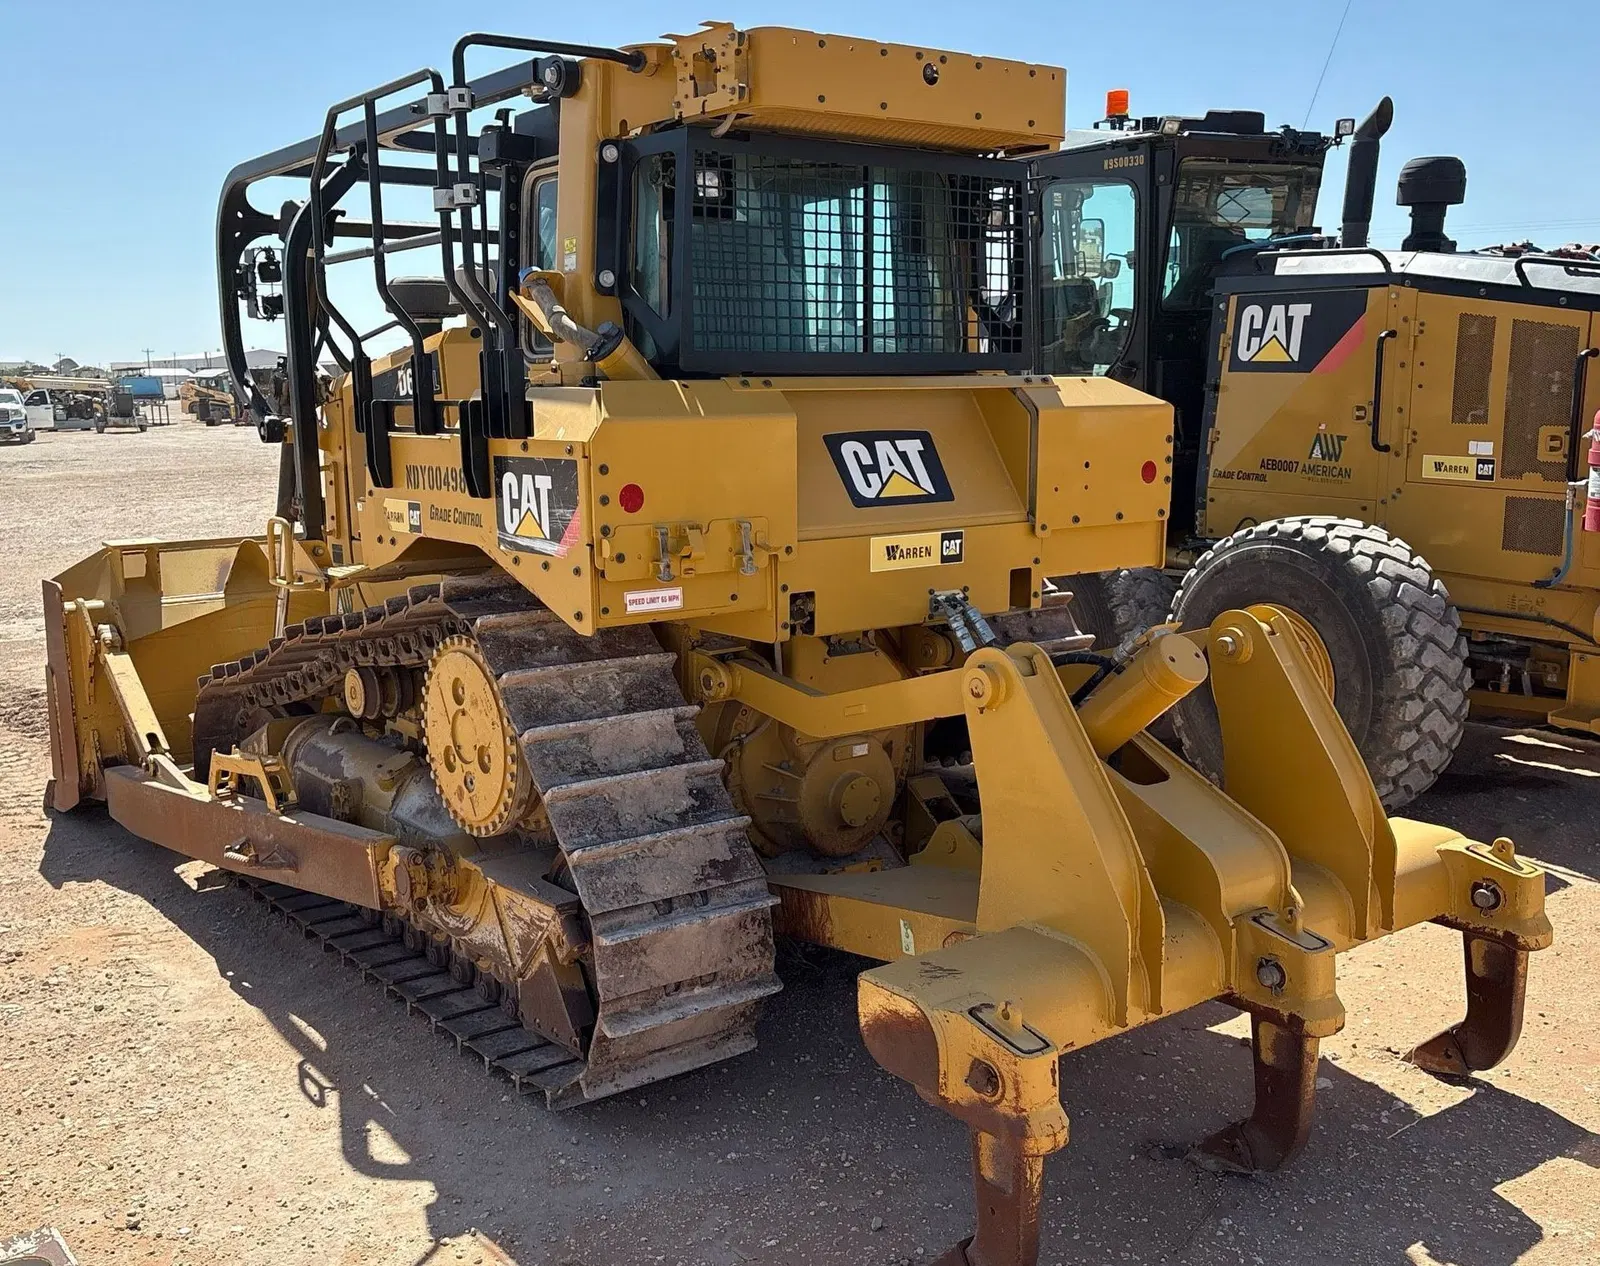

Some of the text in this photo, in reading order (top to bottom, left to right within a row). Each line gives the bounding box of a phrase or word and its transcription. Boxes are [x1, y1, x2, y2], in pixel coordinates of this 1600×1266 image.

[1237, 303, 1312, 362] CAT
[840, 439, 936, 498] CAT
[1259, 458, 1300, 473] AEB0007
[1300, 463, 1352, 479] AMERICAN
[1434, 461, 1494, 475] WARREN CAT
[1212, 468, 1268, 482] GRADE CONTROL
[502, 471, 552, 540] CAT
[383, 507, 421, 525] ARREN CAT
[429, 504, 484, 528] GRADE CONTROL
[885, 539, 962, 561] WARREN CAT
[628, 597, 646, 606] SPEED
[646, 596, 660, 604] LIMIT
[668, 594, 680, 602] MPH
